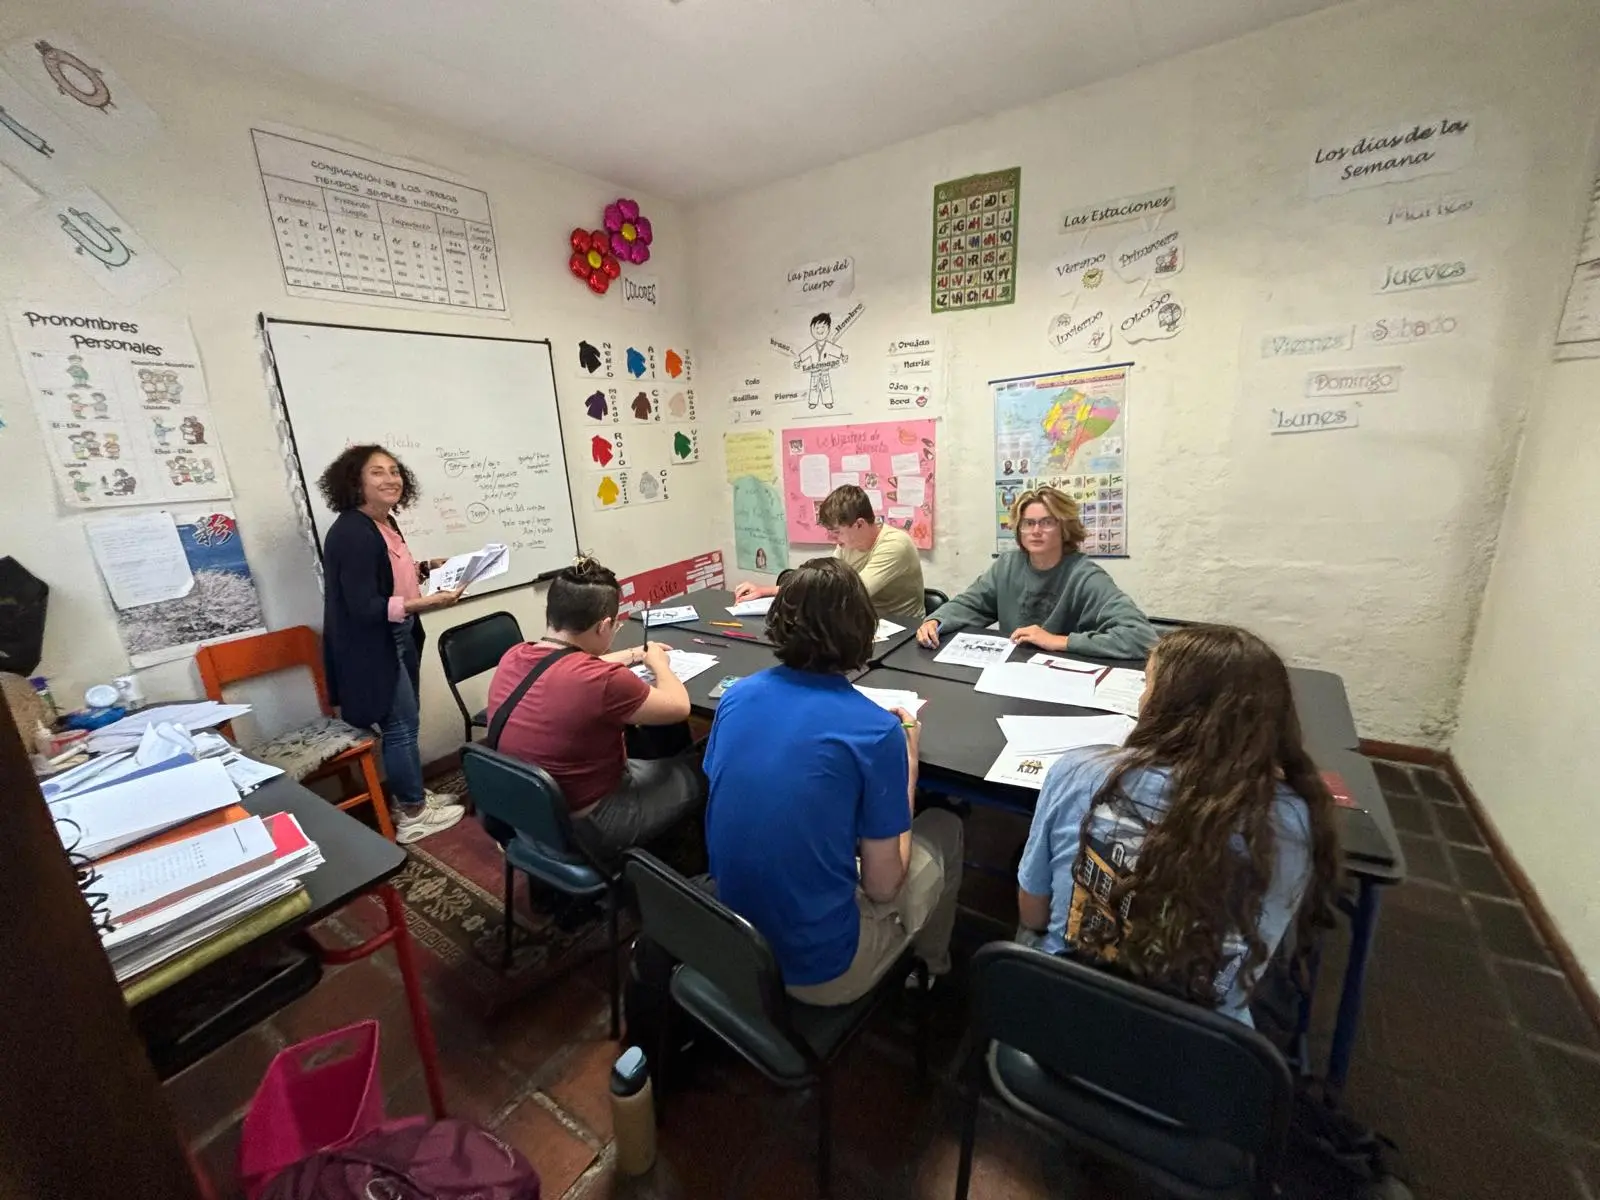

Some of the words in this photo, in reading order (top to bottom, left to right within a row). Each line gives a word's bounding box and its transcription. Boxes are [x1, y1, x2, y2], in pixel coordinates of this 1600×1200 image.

[1315, 147, 1348, 164] Los
[1405, 124, 1437, 143] de
[1440, 119, 1469, 135] la
[402, 184, 421, 193] LOS
[1064, 214, 1088, 228] Las
[1091, 196, 1171, 222] Estaciones
[787, 269, 802, 283] Las
[803, 264, 832, 280] partes
[833, 259, 850, 274] del
[1382, 260, 1466, 289] Jueves
[802, 278, 835, 293] Cuerpo
[23, 311, 139, 334] Pronombres
[70, 334, 163, 356] Personales
[1314, 373, 1393, 392] Domingo
[1278, 408, 1348, 428] Lunes
